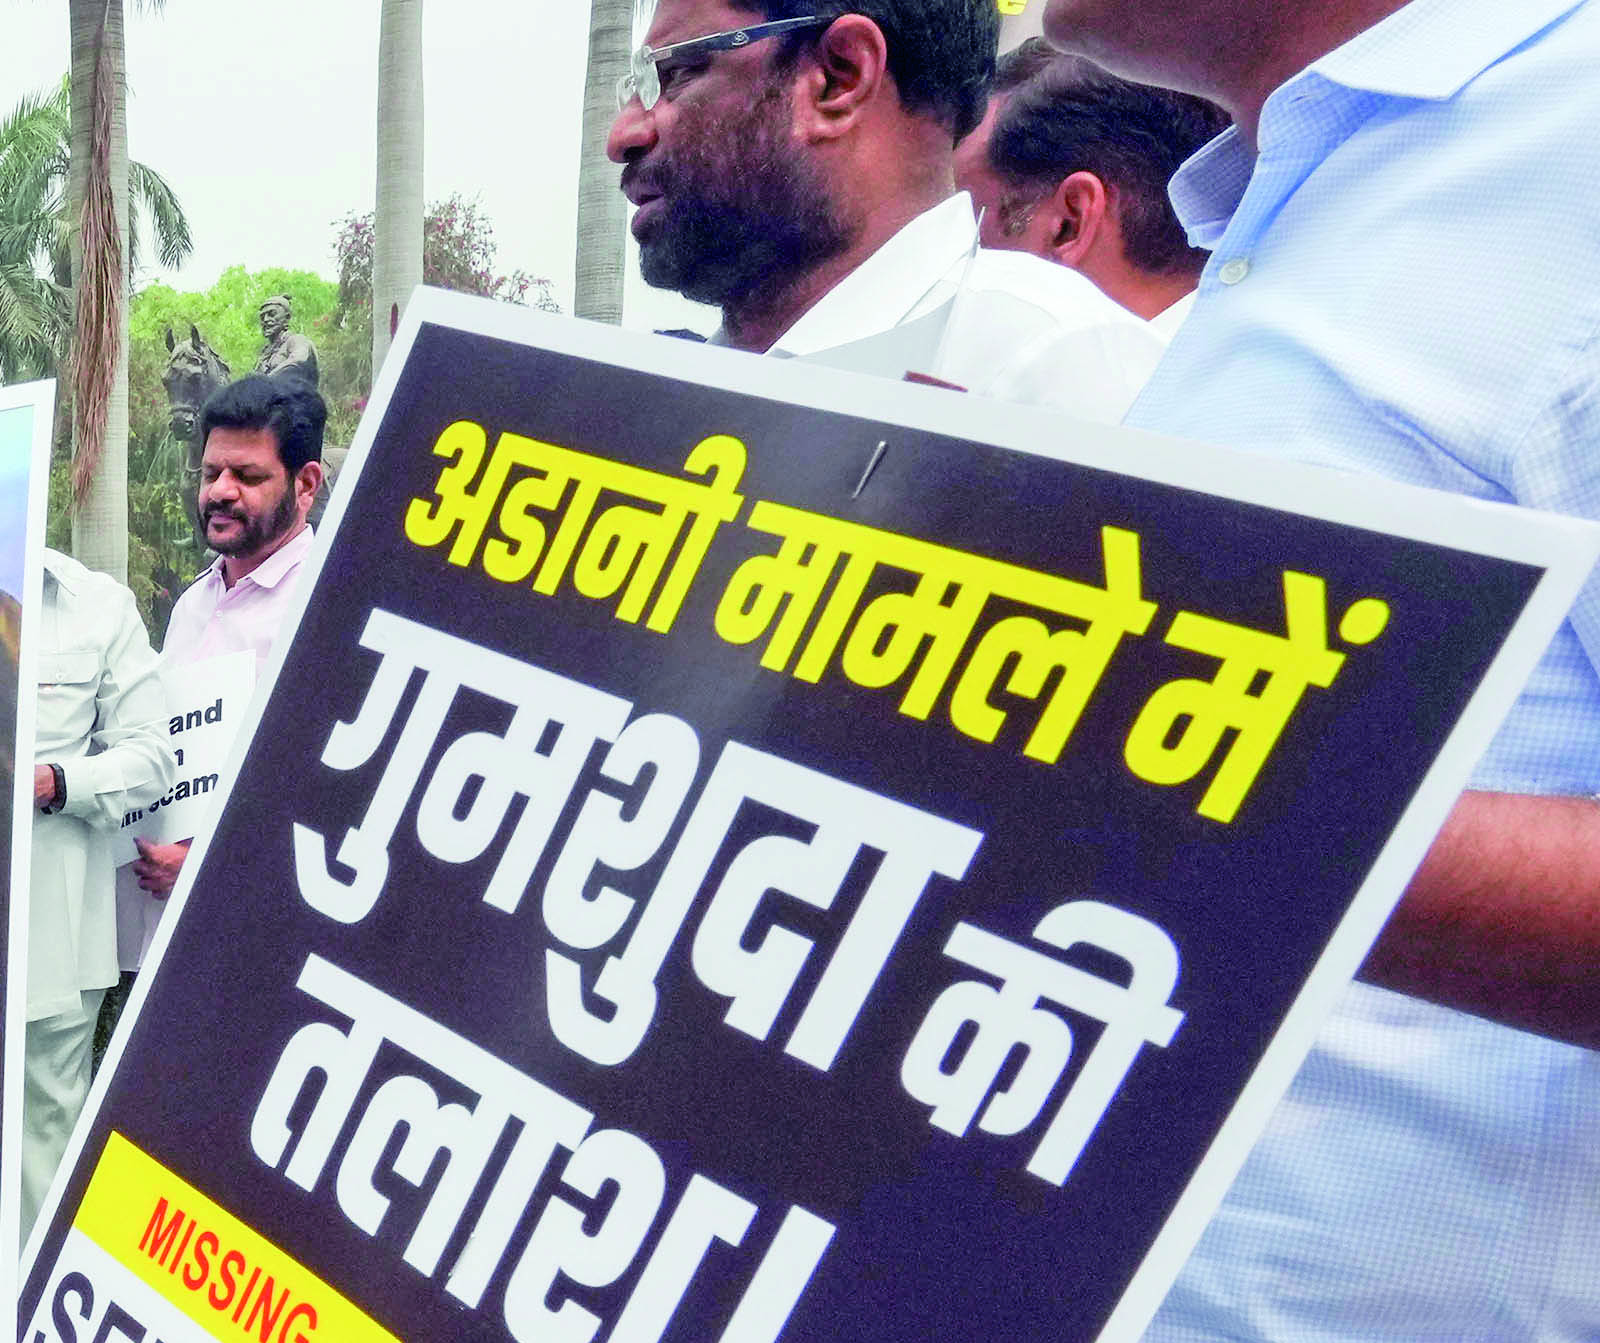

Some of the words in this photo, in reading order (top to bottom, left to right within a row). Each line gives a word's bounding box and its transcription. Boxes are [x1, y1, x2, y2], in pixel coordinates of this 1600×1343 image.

[169, 698, 223, 735] and
[403, 419, 749, 638] अडानी
[713, 495, 1158, 765] मामले
[1124, 568, 1390, 825] में
[291, 606, 986, 1073] गुमशुदा
[901, 898, 1188, 1188] की
